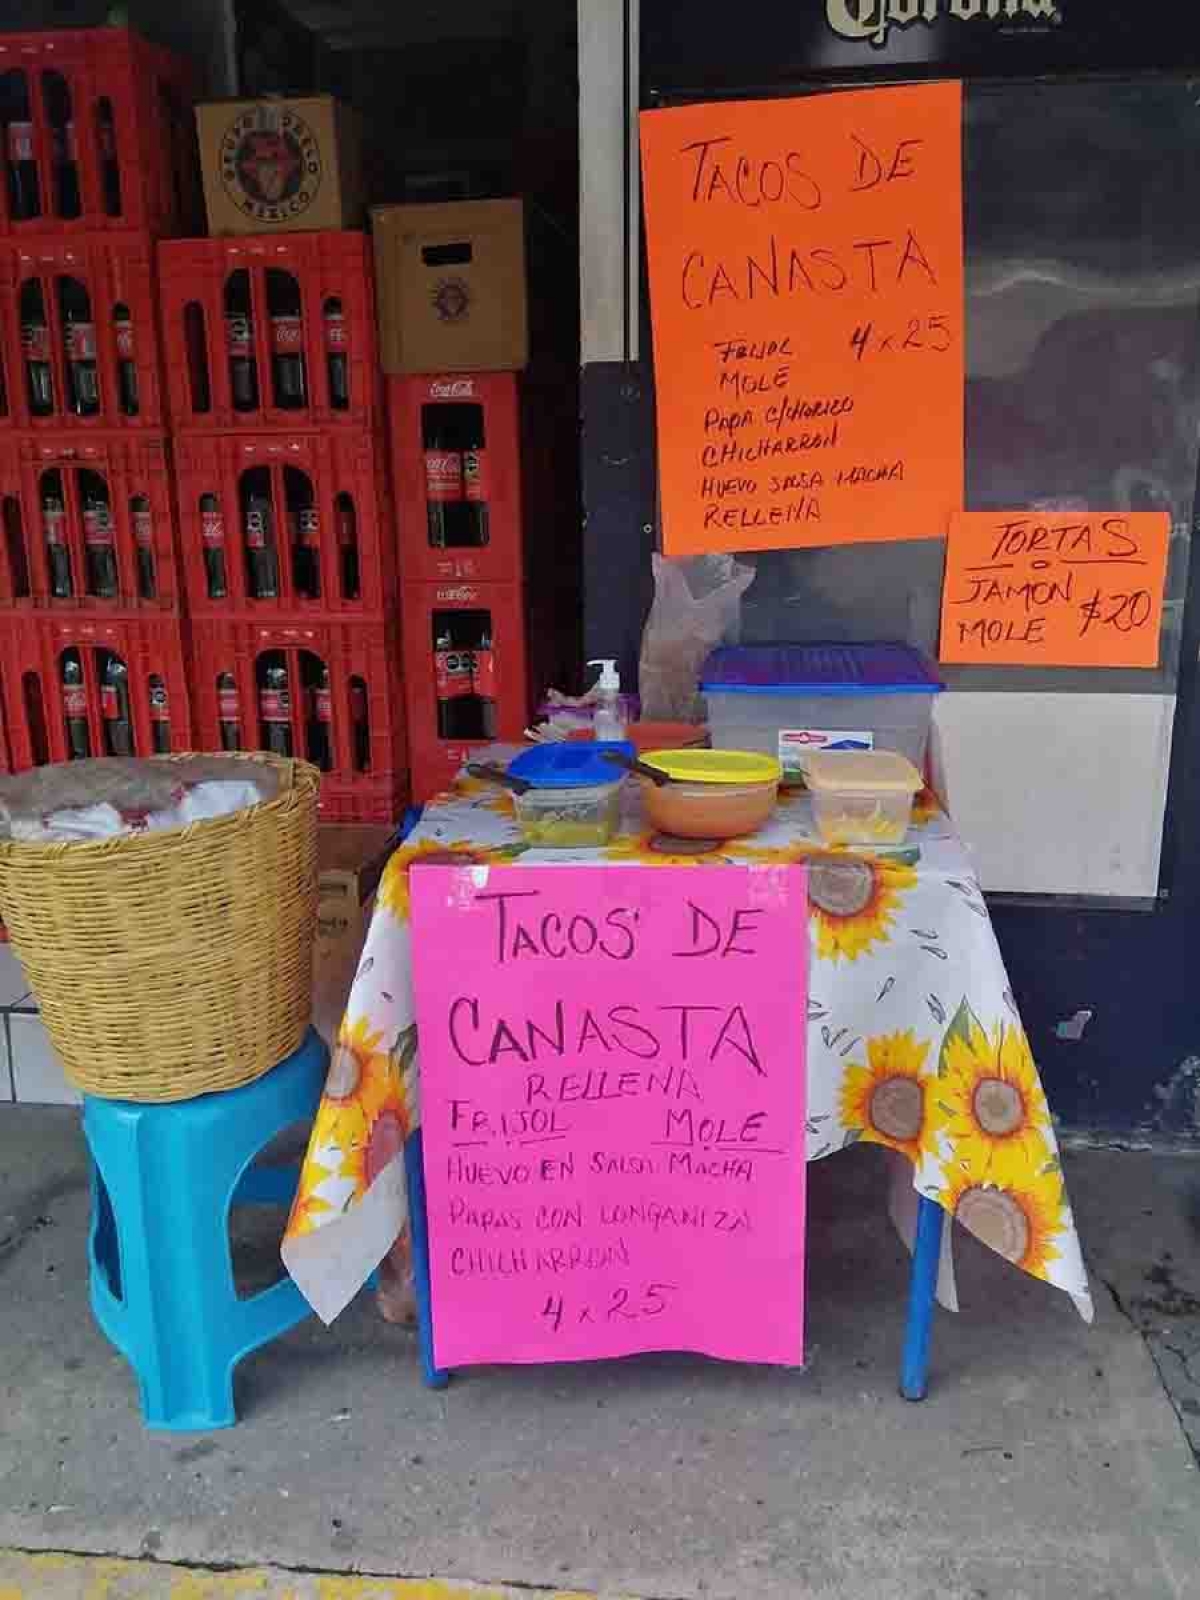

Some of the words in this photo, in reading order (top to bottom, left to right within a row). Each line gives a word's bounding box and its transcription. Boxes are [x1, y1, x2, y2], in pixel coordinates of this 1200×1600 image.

[679, 135, 821, 211] TACOS
[849, 133, 924, 192] DE
[682, 228, 938, 310] CANASTA
[850, 322, 873, 361] 4
[902, 315, 951, 352] 25
[718, 366, 790, 399] MOLE
[703, 408, 753, 437] PAPA
[701, 421, 839, 468] CHICHARRON
[701, 475, 757, 499] HUEVO
[703, 498, 821, 529] RELLENA
[991, 519, 1138, 560] TORTAS
[949, 571, 1072, 612] JAMON
[959, 618, 1046, 648] MOLE
[1079, 589, 1151, 637] $20
[474, 889, 641, 963] TACOS
[671, 899, 764, 958] DE
[448, 996, 767, 1078] CANASTA
[525, 1066, 703, 1105] RELLENA
[447, 1099, 570, 1137] FRIJOL
[665, 1107, 768, 1147] MOLE
[447, 1154, 530, 1186] HUEVO
[540, 1151, 575, 1182] EN
[587, 1151, 654, 1177] SALSA
[668, 1152, 755, 1183] MACHA
[449, 1198, 523, 1232] PAPAS
[534, 1202, 583, 1230] CON
[600, 1202, 753, 1232] LONGANIZA
[450, 1237, 631, 1277] CHICHARRON
[541, 1295, 565, 1332] 4
[607, 1281, 680, 1320] 25
